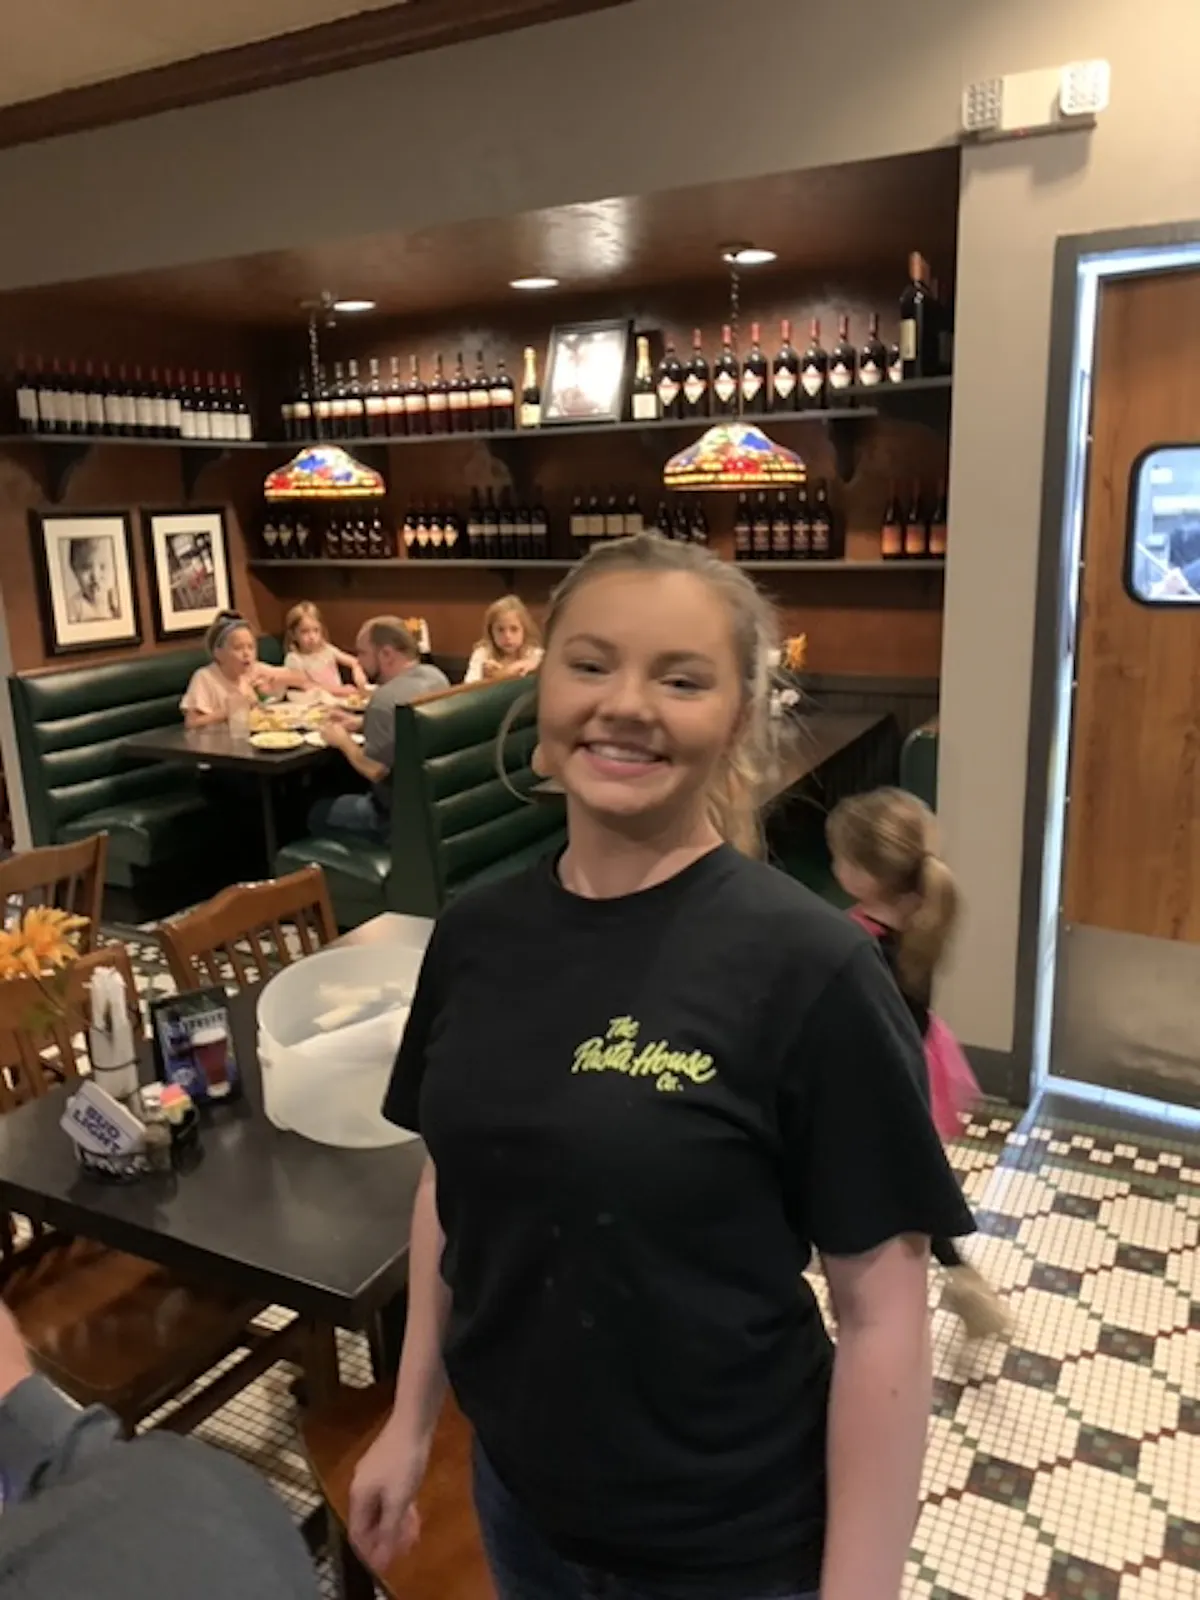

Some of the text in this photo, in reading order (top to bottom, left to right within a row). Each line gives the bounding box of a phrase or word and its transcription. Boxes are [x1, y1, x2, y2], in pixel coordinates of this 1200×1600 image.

[606, 1015, 640, 1039] The
[571, 1036, 718, 1083] Pasta House
[72, 1109, 122, 1156] LIGHT
[86, 1105, 120, 1139] BUD
